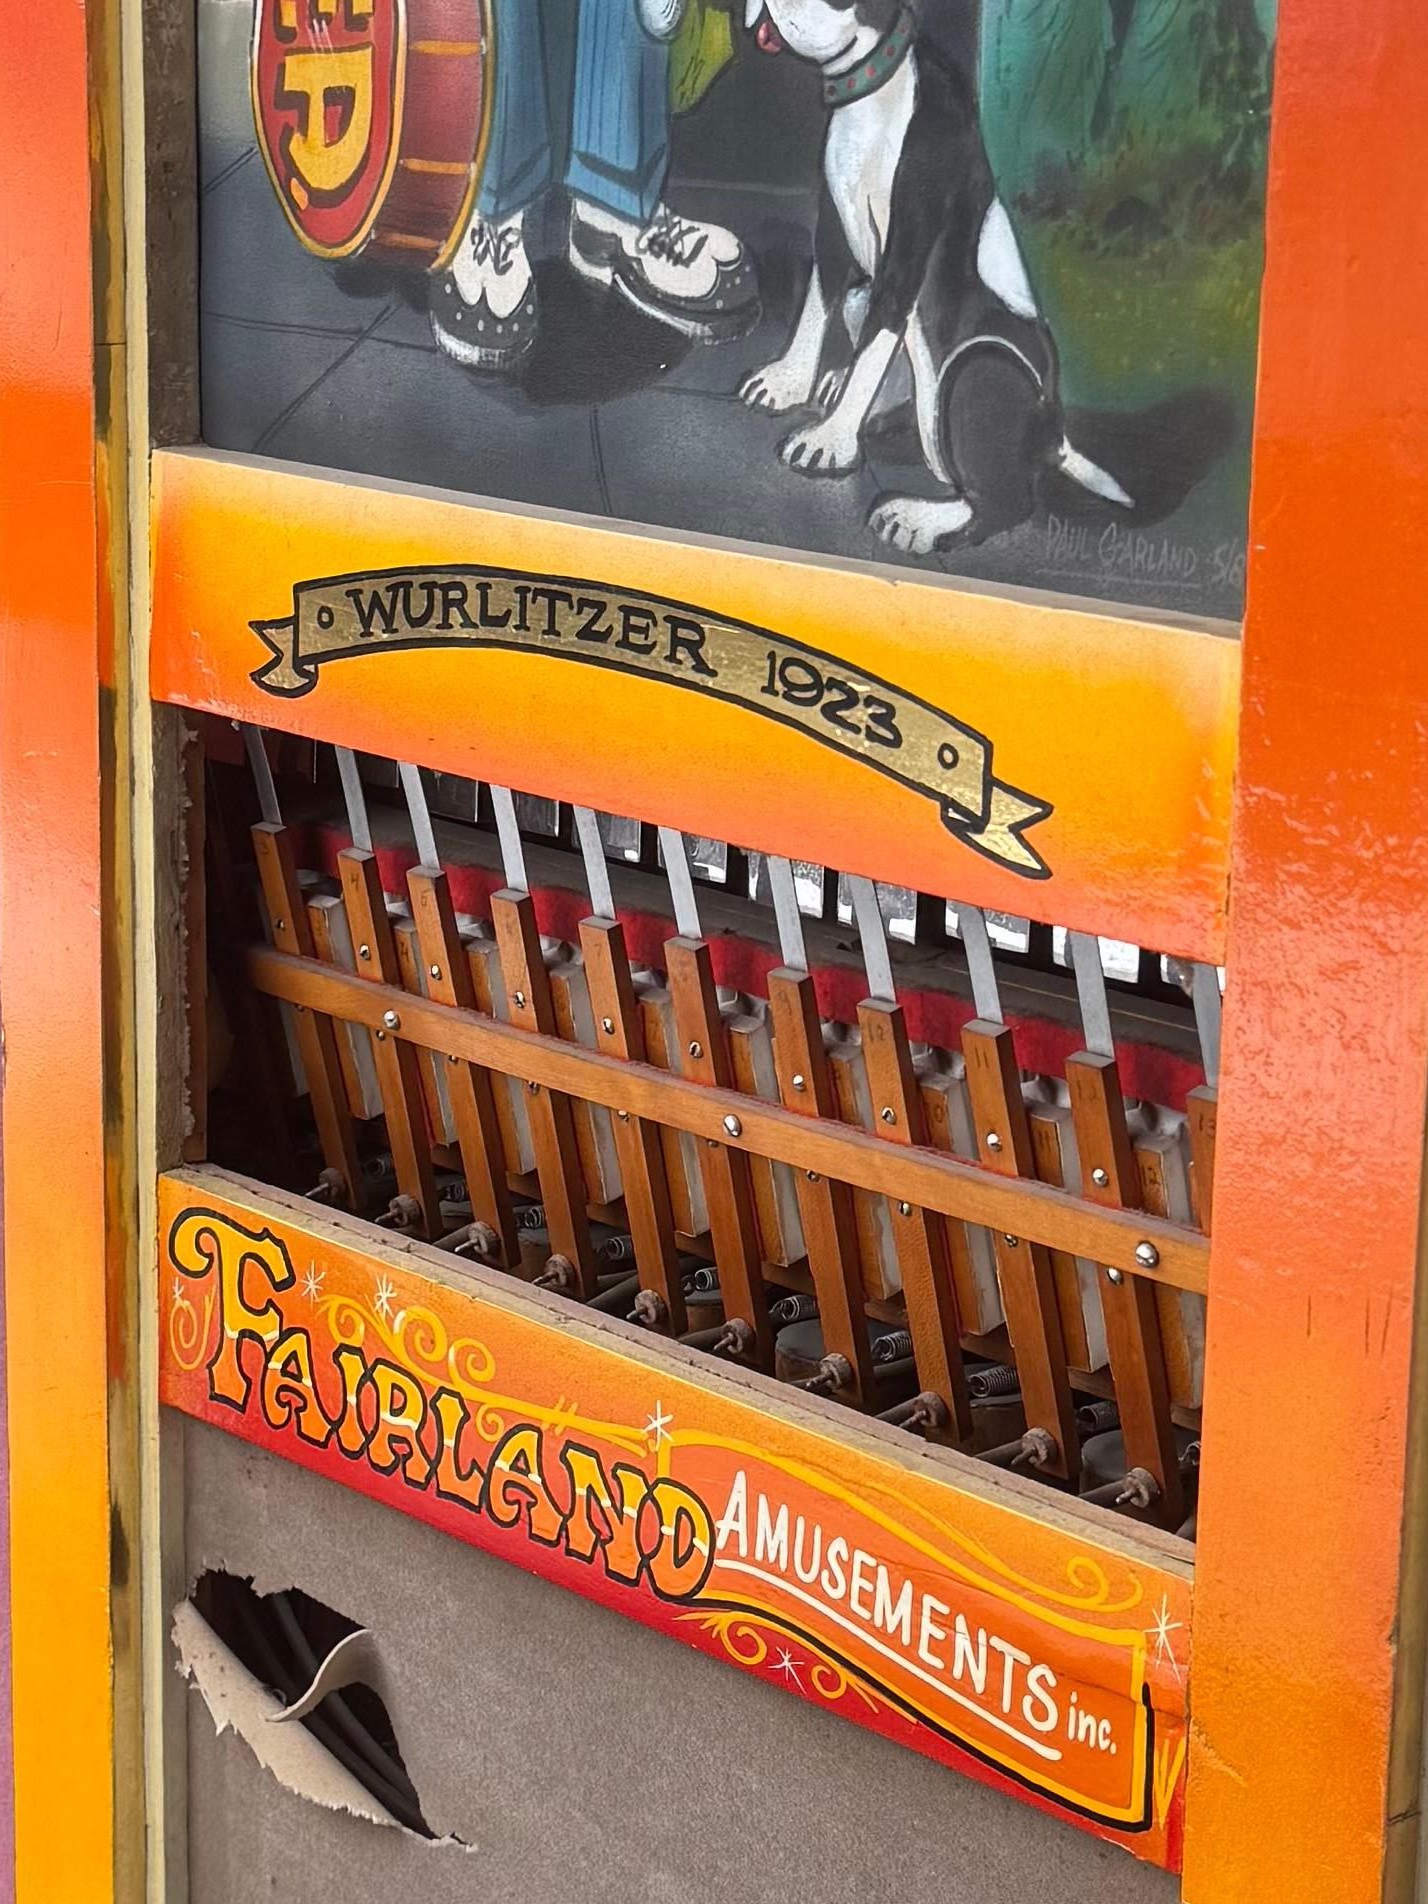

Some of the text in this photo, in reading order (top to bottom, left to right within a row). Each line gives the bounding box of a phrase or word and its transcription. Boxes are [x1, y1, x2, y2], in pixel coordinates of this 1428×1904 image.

[1045, 513, 1093, 561] PAUL
[1098, 522, 1197, 578] GARLAND
[349, 582, 903, 749] WURLITZER 1923
[168, 1206, 1118, 1756] FAIRLAND AMUSEMENTS inc.
